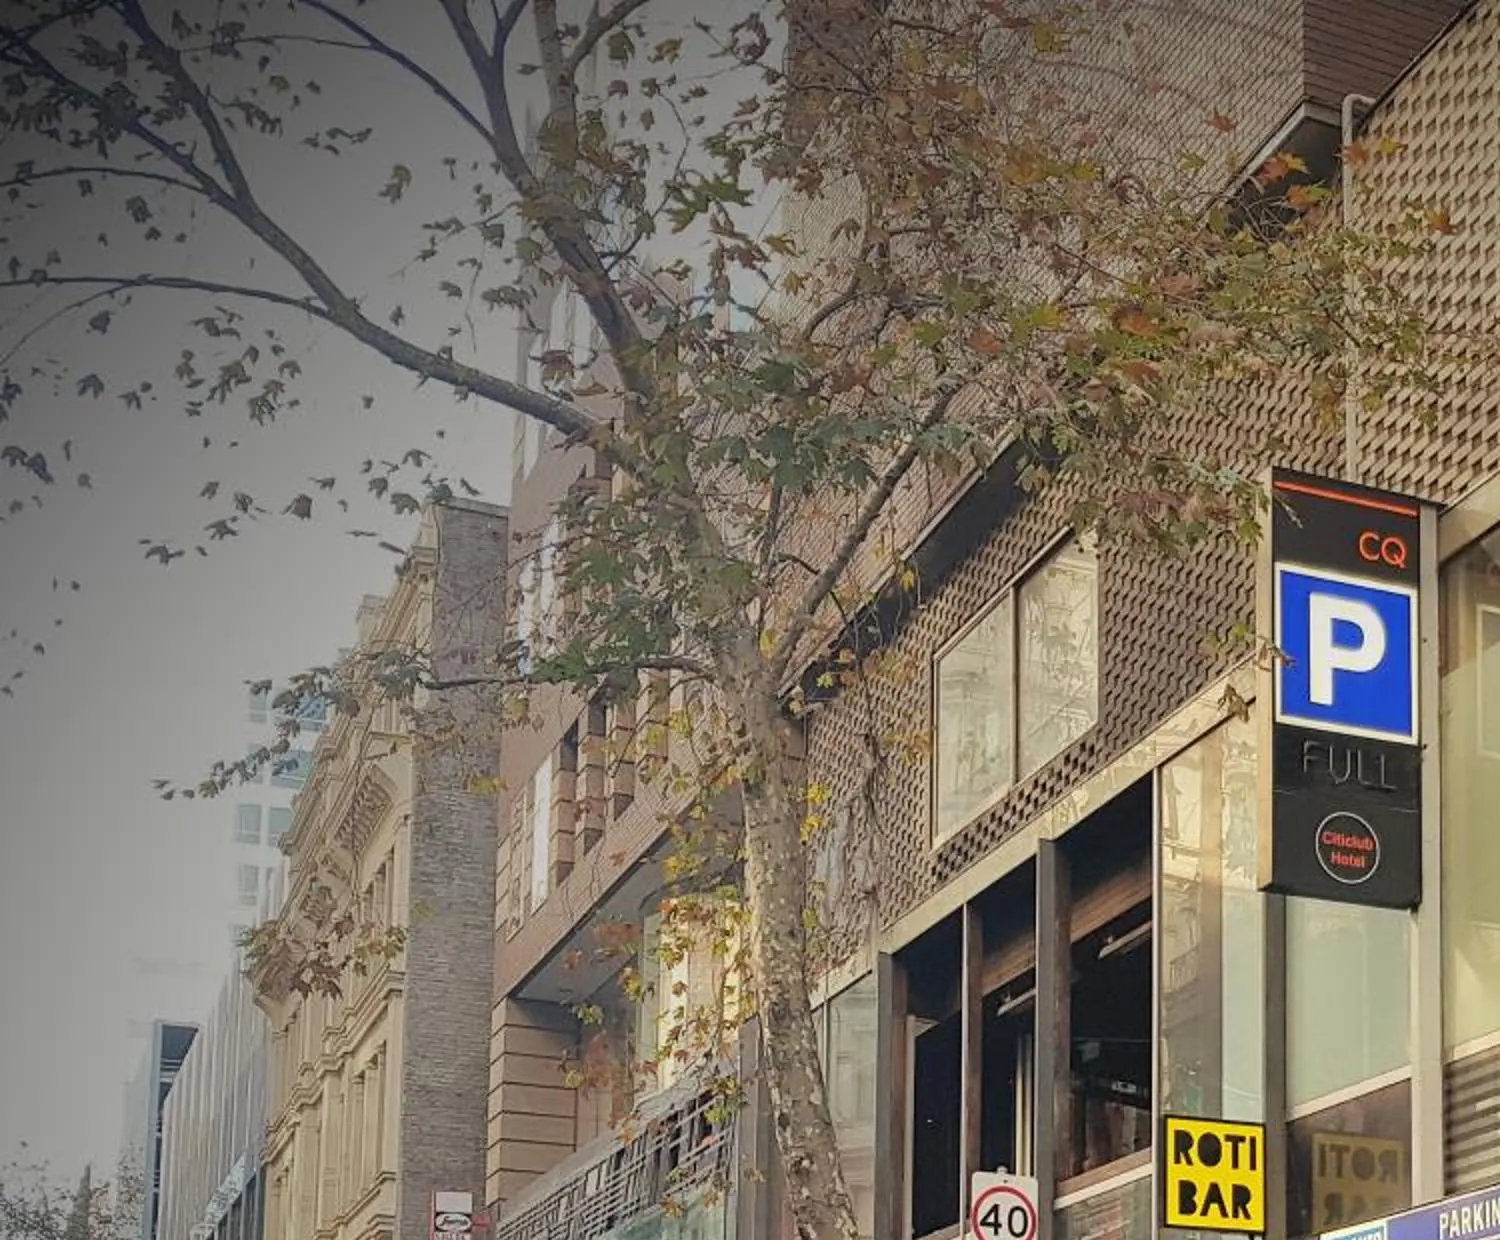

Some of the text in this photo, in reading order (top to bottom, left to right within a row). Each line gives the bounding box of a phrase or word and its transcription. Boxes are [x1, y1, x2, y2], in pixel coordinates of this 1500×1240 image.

[1358, 530, 1408, 568] CQ
[1308, 590, 1387, 706] P
[1301, 740, 1397, 790] FULL
[1321, 831, 1374, 853] Citiclub
[1330, 850, 1366, 869] Hotel
[1172, 1128, 1258, 1172] ROTI
[1177, 1181, 1253, 1221] BAR
[979, 1203, 1029, 1239] 40
